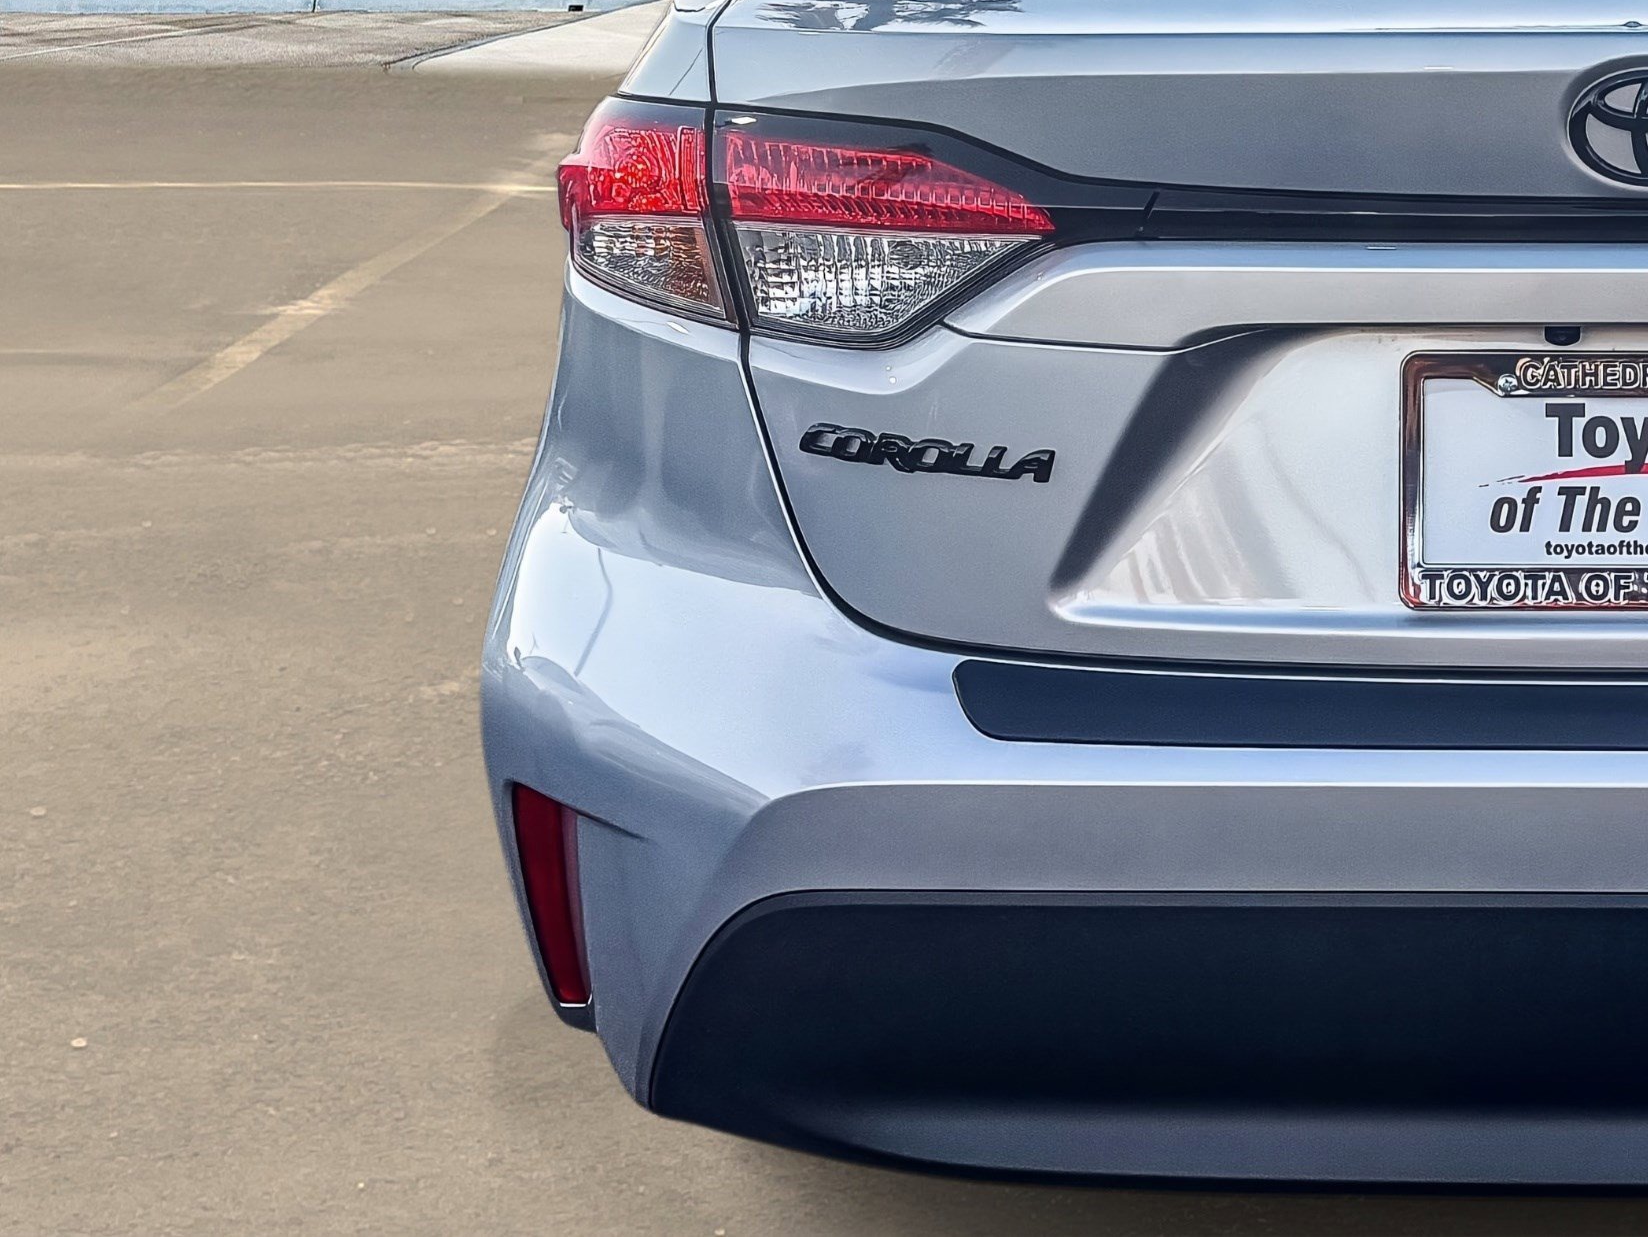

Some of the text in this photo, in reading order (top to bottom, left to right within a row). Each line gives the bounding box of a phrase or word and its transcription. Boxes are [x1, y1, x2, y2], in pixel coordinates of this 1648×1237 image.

[799, 422, 1056, 483] COROLLA
[1489, 486, 1542, 533] of
[1556, 486, 1641, 533] The
[1421, 571, 1566, 604] TOYOTA
[1583, 571, 1637, 604] OF
